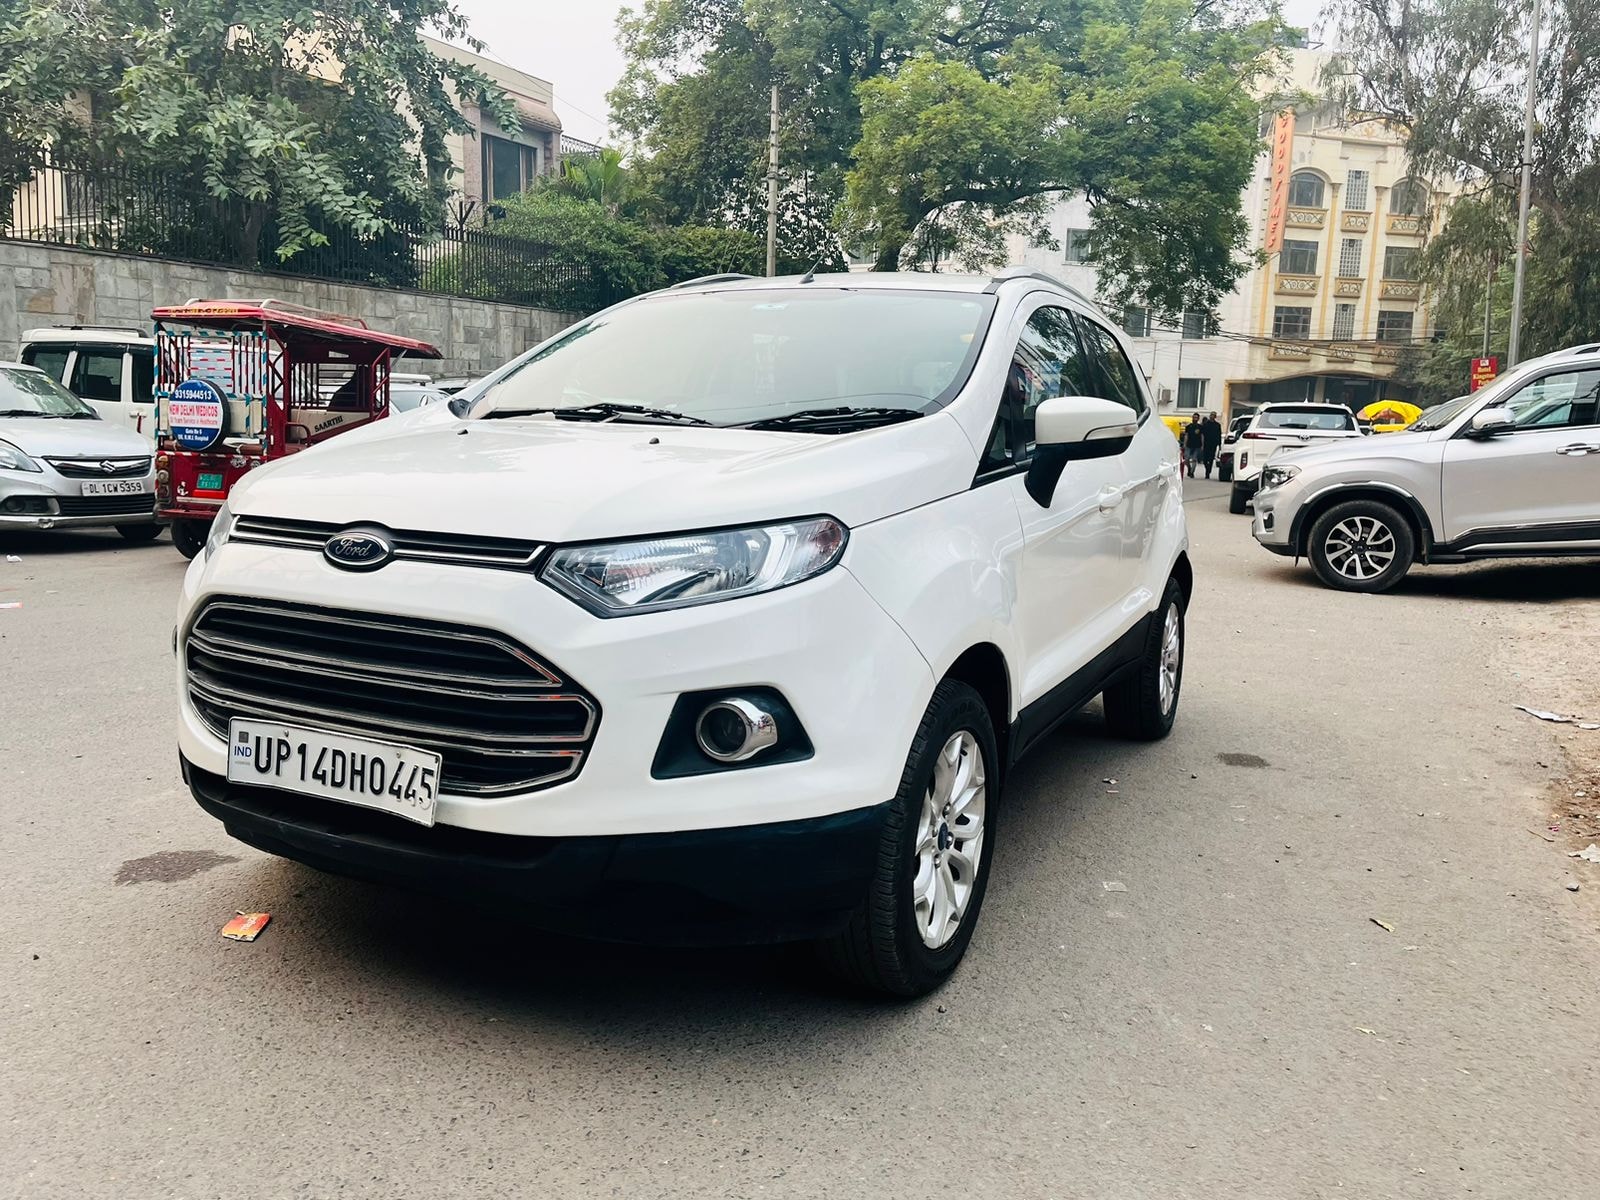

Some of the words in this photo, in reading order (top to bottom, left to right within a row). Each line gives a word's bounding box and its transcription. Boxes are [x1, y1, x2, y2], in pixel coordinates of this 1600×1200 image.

[314, 415, 344, 432] SAARTHI
[335, 537, 372, 557] Ford
[234, 746, 251, 757] IND
